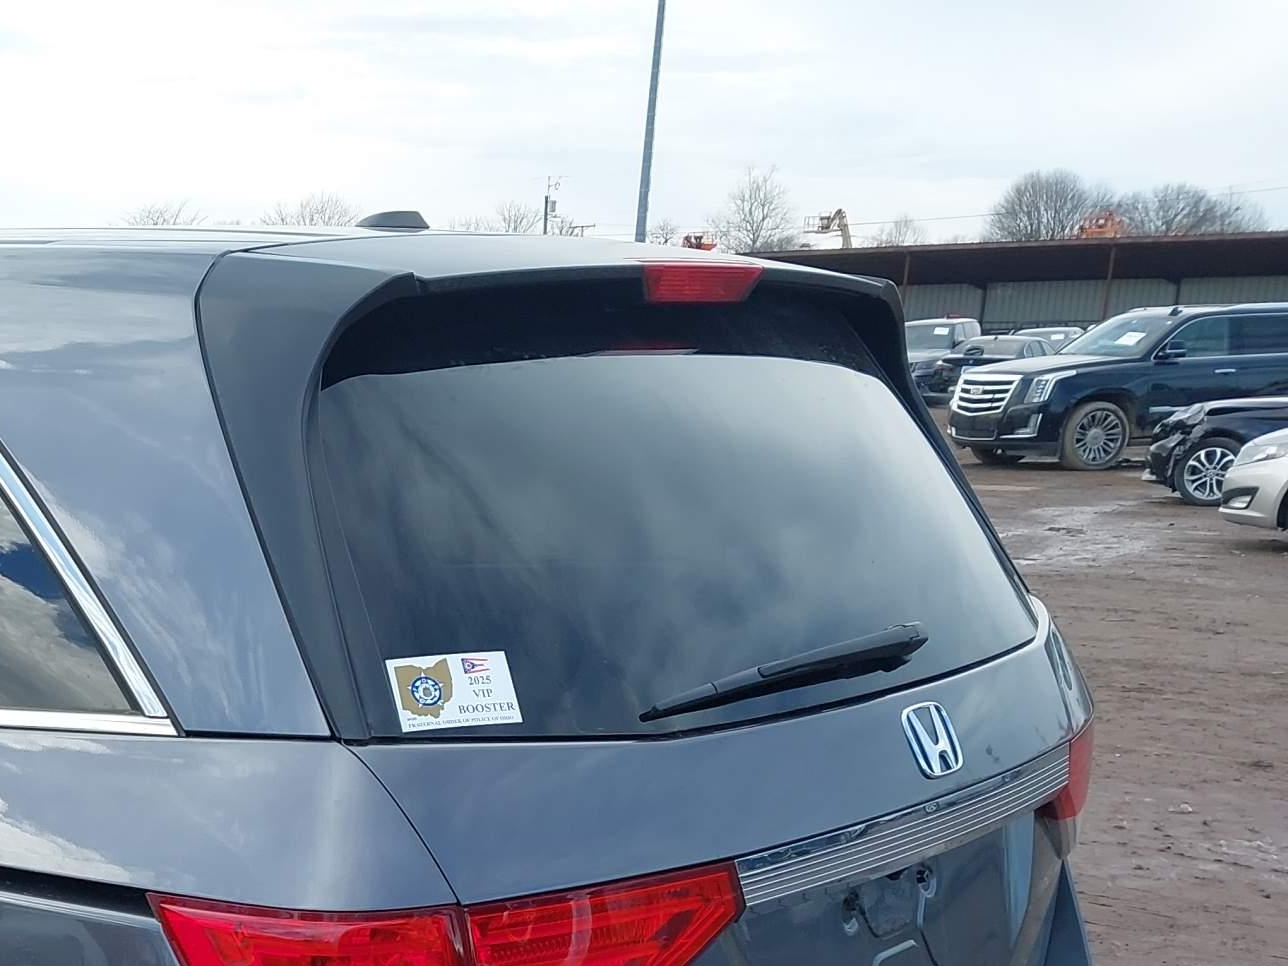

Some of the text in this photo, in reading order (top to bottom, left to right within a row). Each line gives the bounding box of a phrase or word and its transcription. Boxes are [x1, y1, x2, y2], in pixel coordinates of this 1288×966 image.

[468, 675, 492, 686] 2025
[472, 688, 493, 698] VIP
[458, 702, 516, 714] BOOSTER
